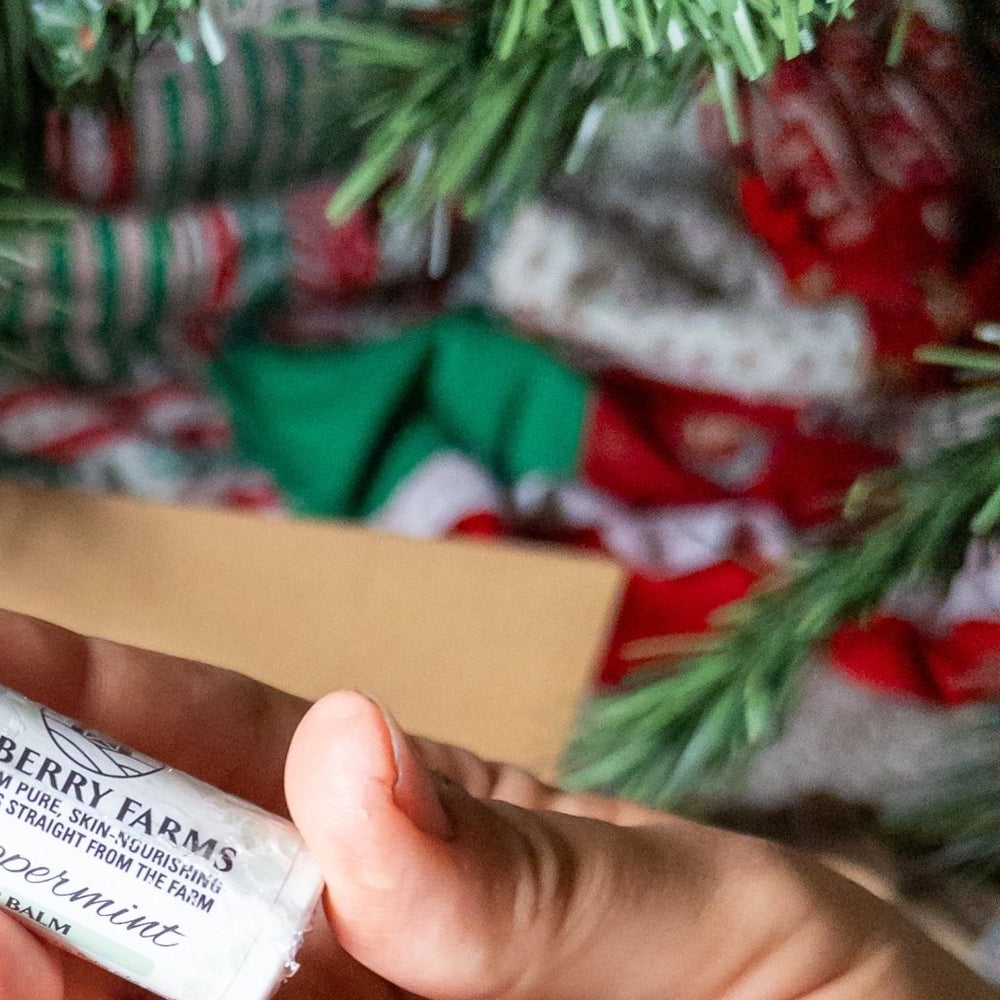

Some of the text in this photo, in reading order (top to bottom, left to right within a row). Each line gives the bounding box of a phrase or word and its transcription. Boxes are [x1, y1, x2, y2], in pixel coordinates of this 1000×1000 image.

[6, 800, 87, 848] STRAIGHT
[86, 839, 133, 873] FROM
[135, 862, 167, 890] THE
[167, 880, 215, 913] FARM
[15, 782, 63, 818] PURE,
[69, 808, 223, 894] SKIN-NOURISHING
[115, 797, 237, 872] FARMS
[5, 896, 71, 936] BALM
